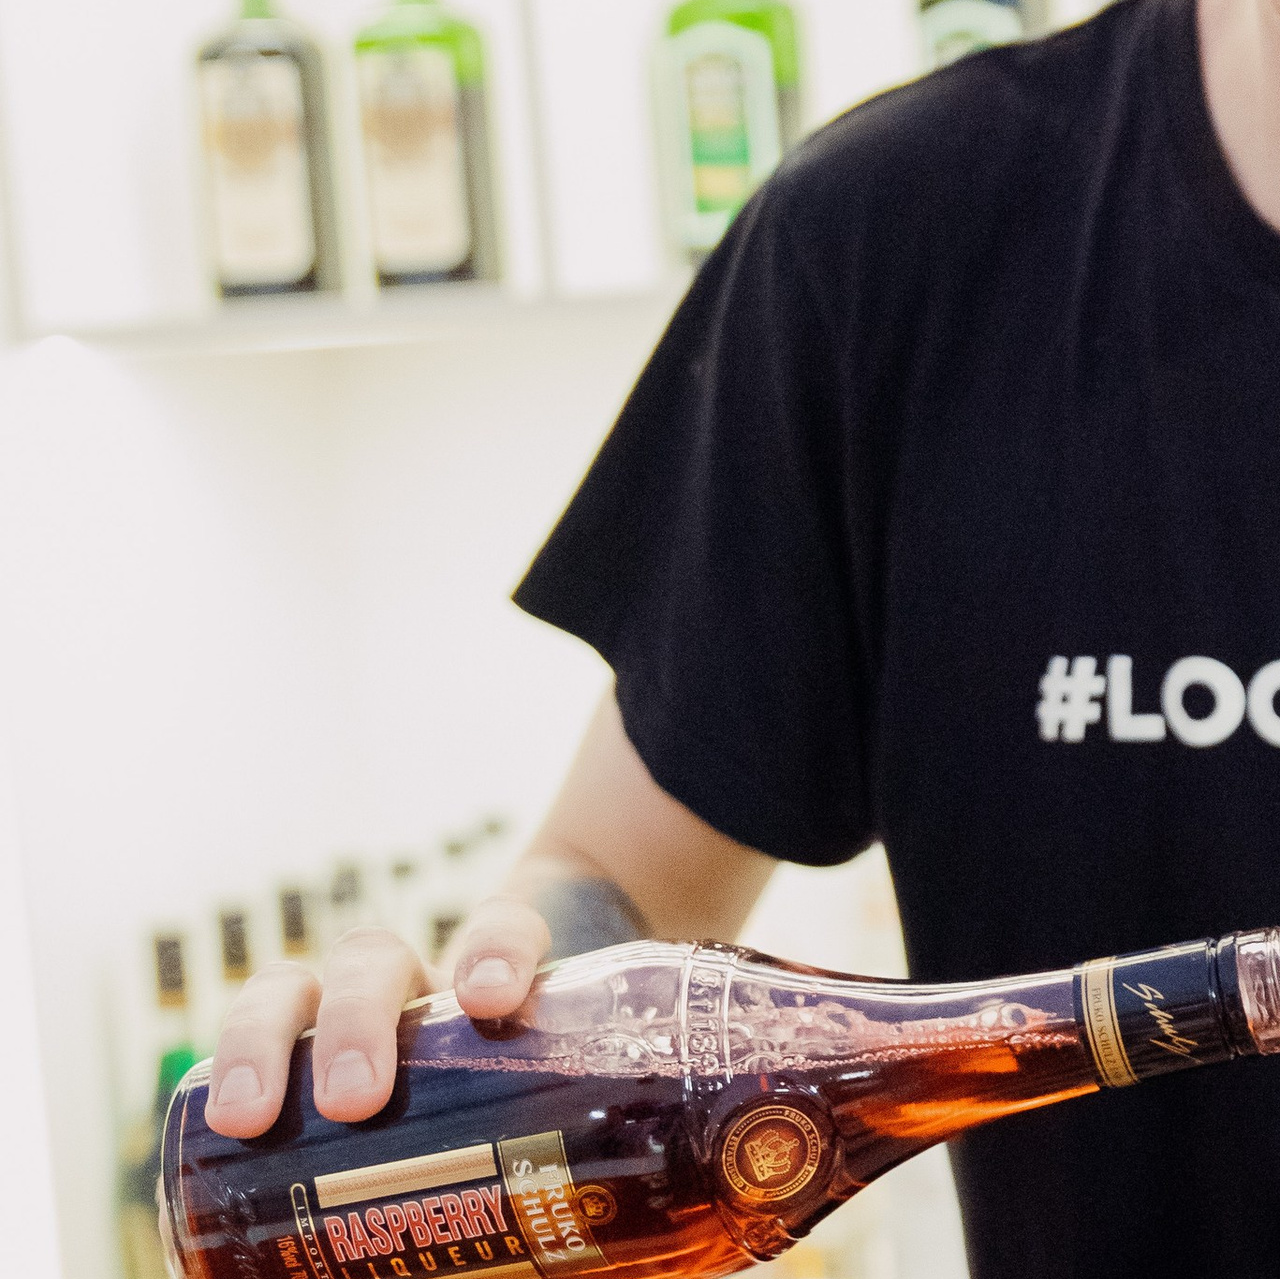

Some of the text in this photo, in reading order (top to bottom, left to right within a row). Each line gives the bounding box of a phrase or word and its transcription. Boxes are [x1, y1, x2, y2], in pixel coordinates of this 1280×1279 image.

[323, 1183, 510, 1264] RASPBERRY
[512, 1158, 569, 1263] SCHULZ
[539, 1164, 586, 1252] FRUKO
